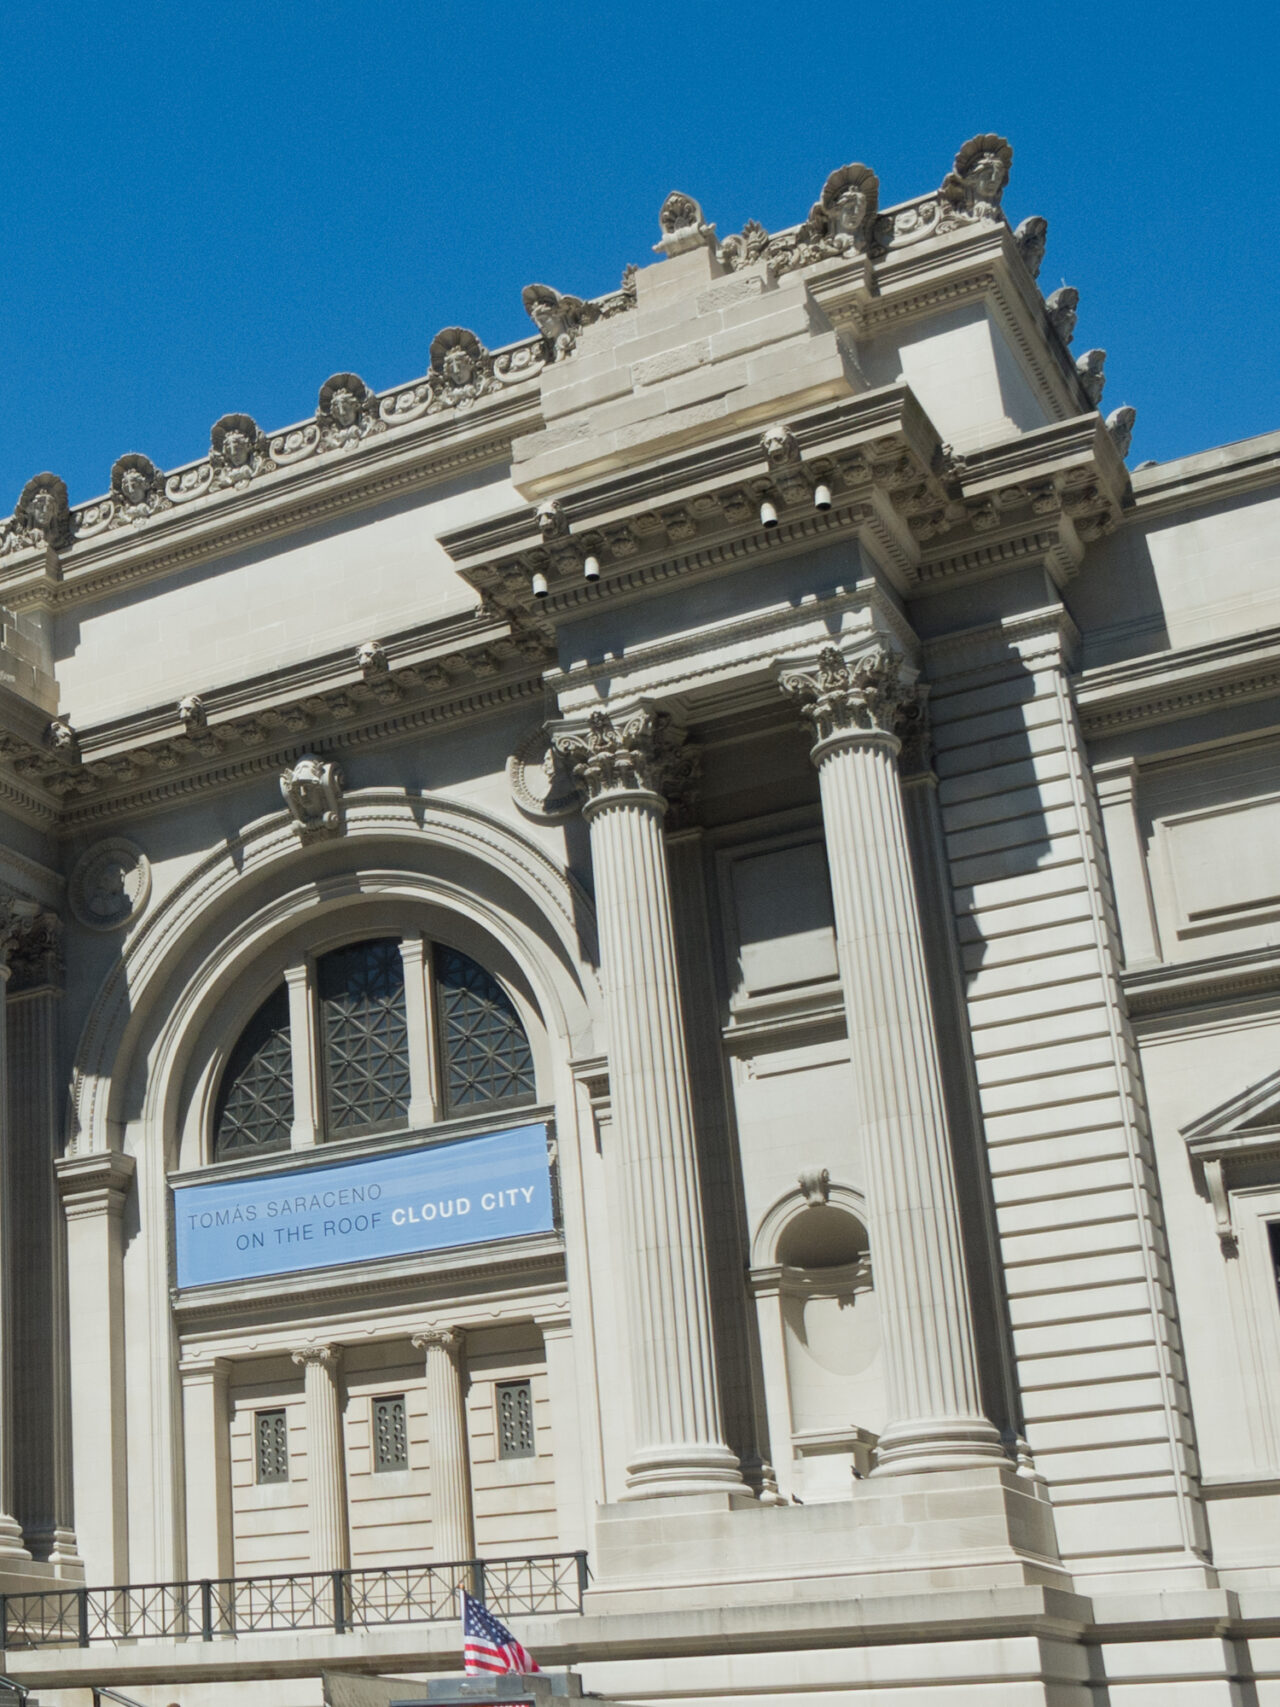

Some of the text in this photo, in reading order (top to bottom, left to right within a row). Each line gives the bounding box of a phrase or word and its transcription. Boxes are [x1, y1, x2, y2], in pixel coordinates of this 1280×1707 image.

[187, 1183, 383, 1231] TOMÁS SARACENO
[235, 1185, 536, 1251] ON THE ROOF CLOUD CITY
